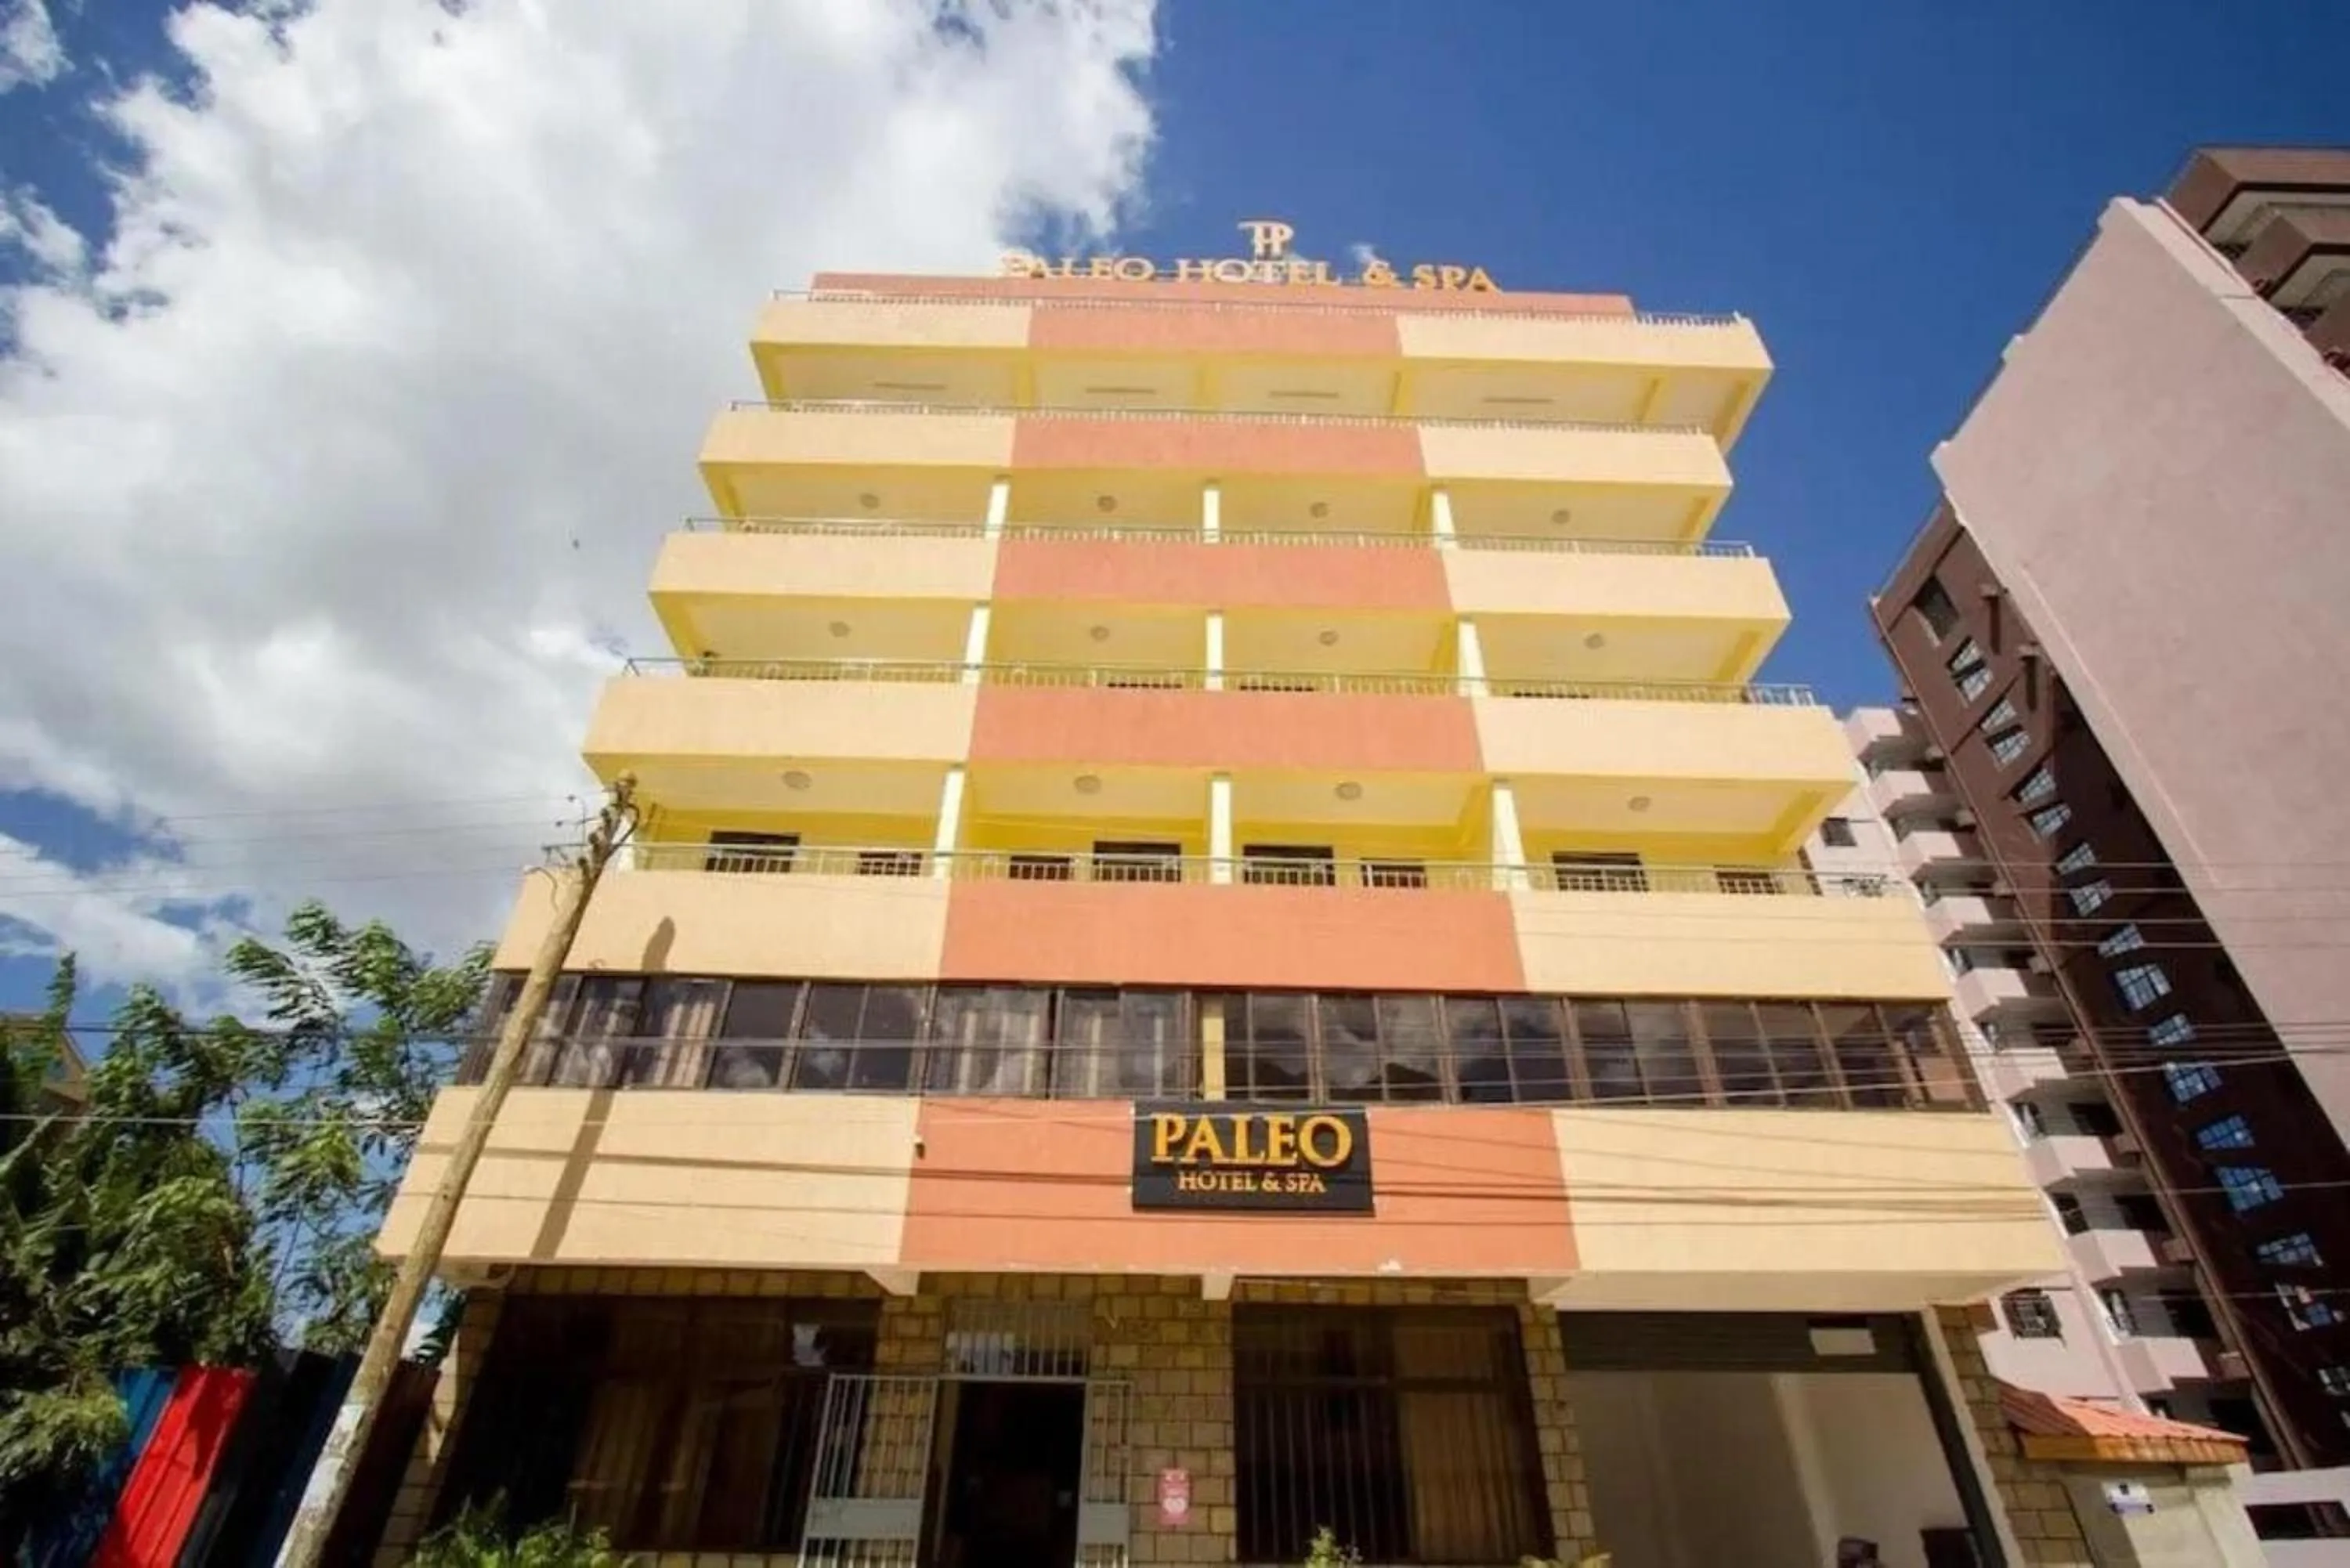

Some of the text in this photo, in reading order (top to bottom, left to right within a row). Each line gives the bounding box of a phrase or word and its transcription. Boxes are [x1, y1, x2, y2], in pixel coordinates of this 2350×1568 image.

[1001, 251, 1505, 294] PALEO HOTEL & SPA
[1151, 1112, 1353, 1167] PALEO
[1178, 1170, 1327, 1193] HOTEL & SPA
